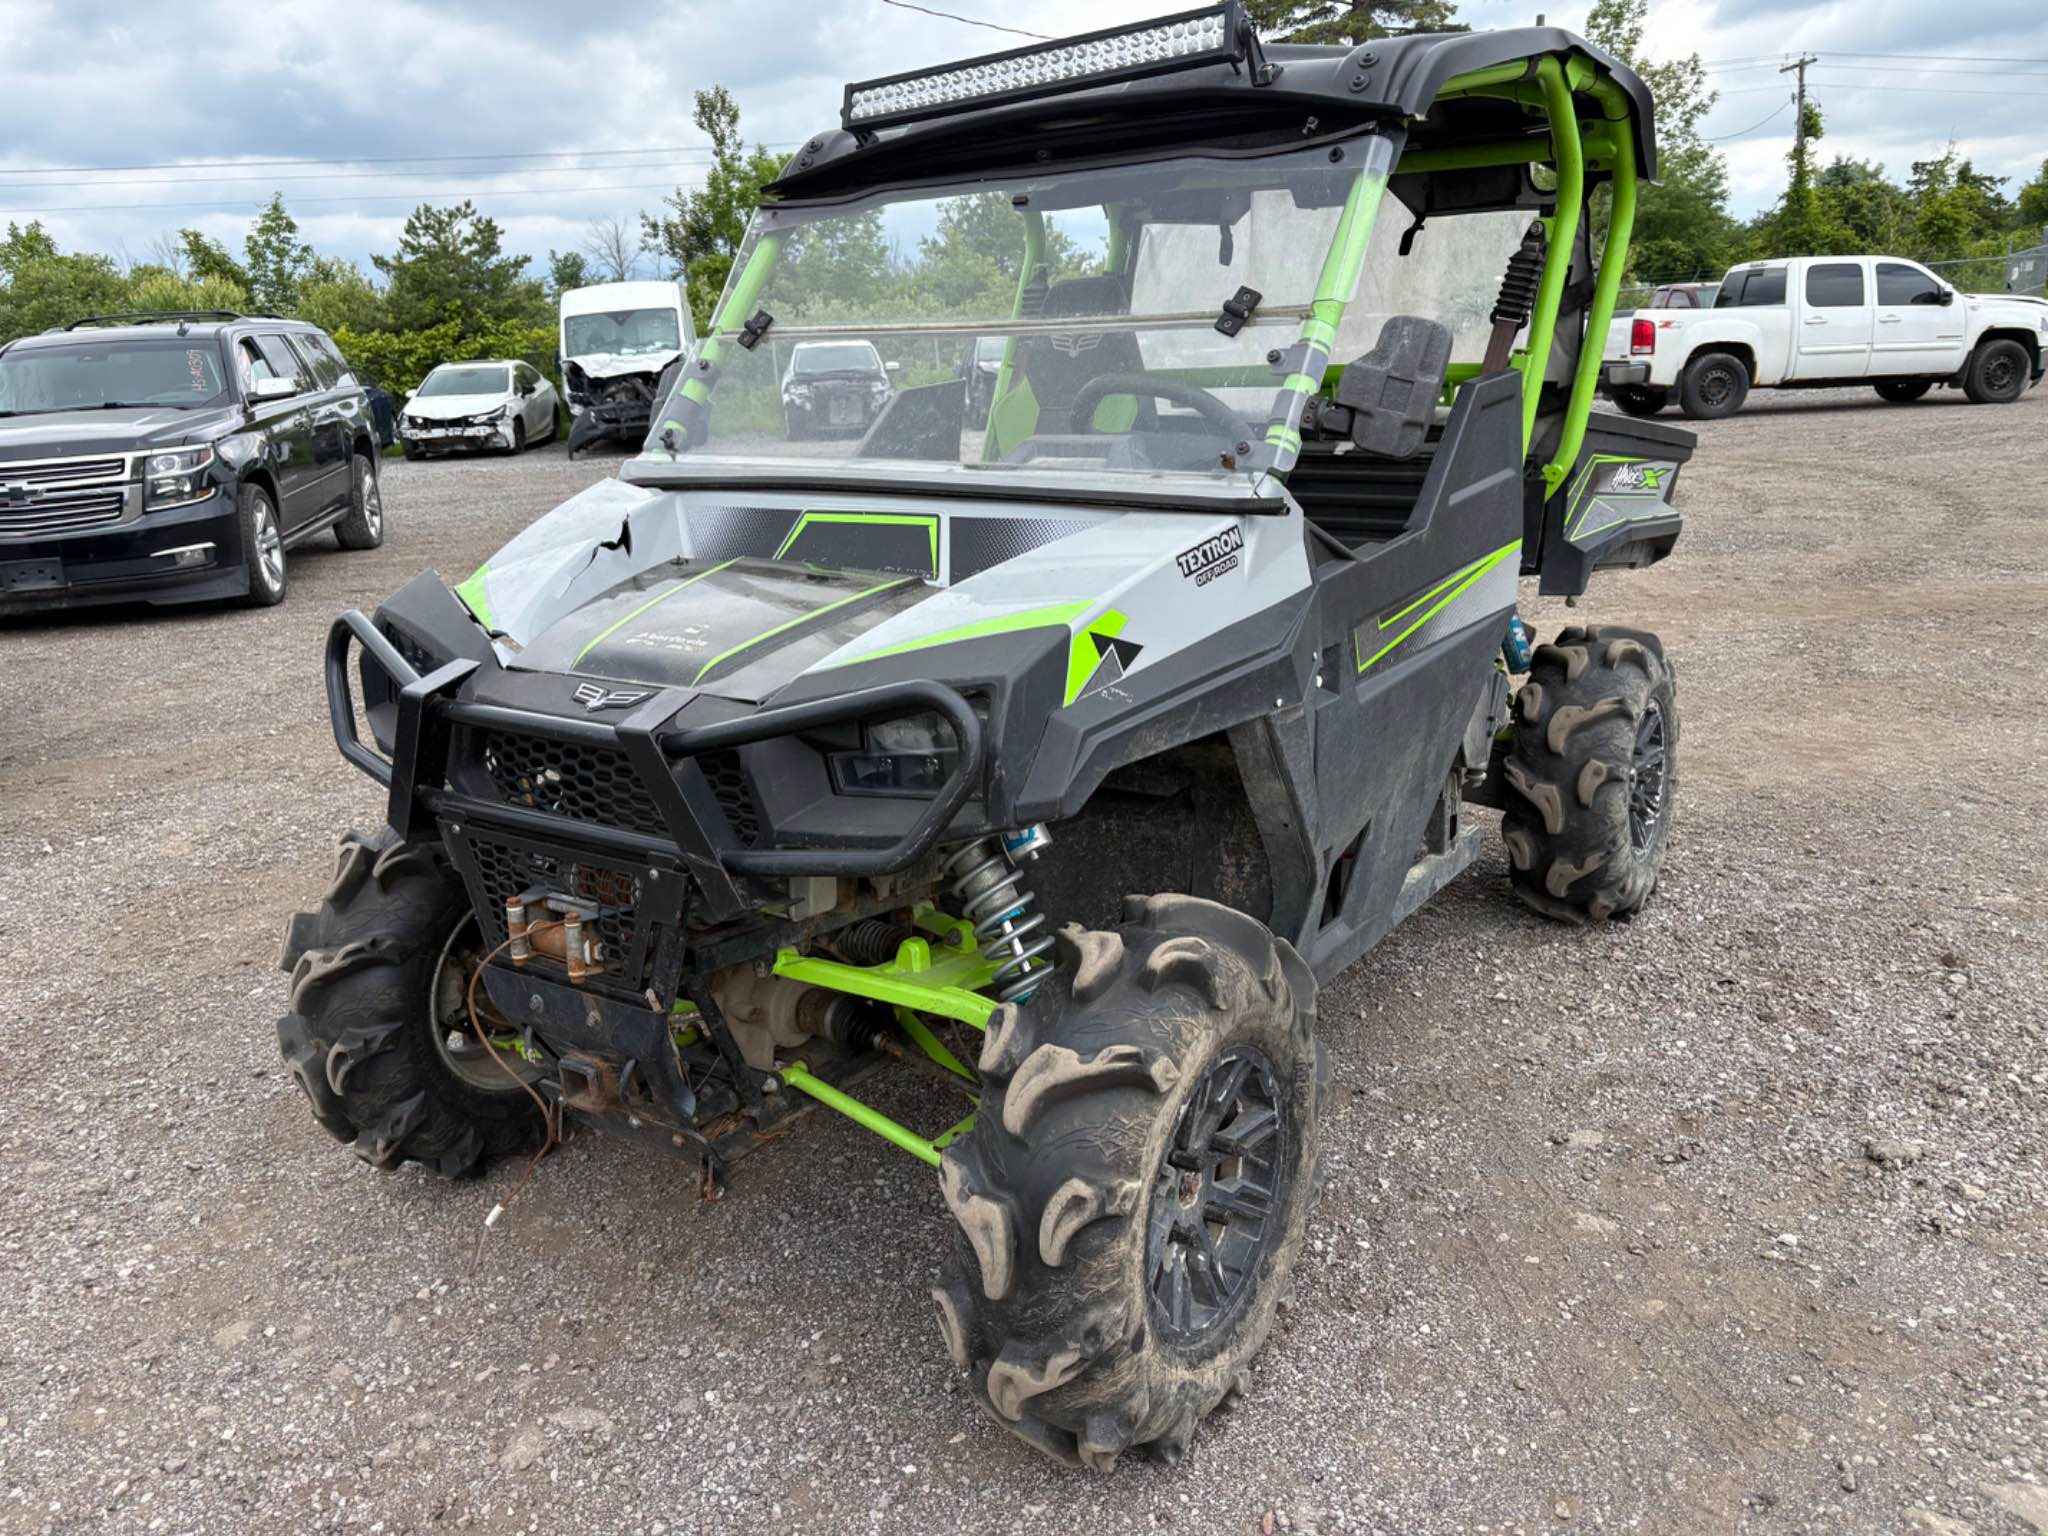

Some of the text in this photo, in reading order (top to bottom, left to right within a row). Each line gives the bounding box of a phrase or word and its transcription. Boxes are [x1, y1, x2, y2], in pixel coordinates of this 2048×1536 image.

[1637, 466, 1672, 490] X
[1177, 526, 1243, 576] TEXTRON
[1197, 556, 1238, 586] OFF ROAD
